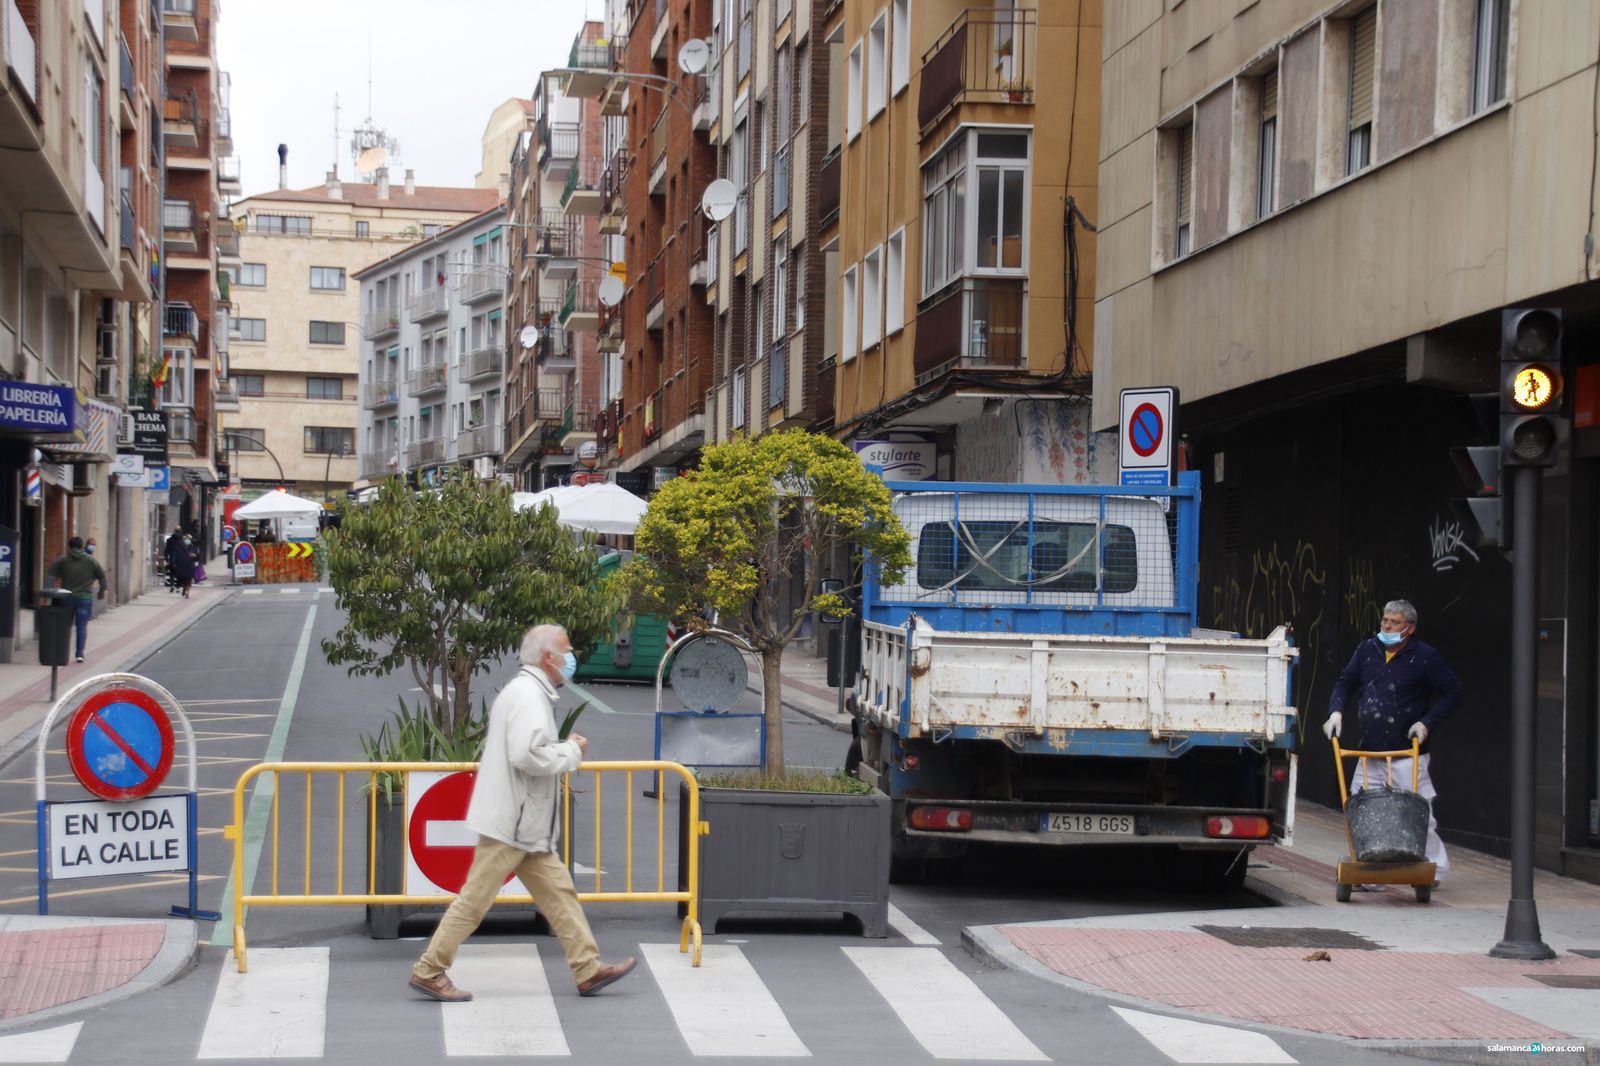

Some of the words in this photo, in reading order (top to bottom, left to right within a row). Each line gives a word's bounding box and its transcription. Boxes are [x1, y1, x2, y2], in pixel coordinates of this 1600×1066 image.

[3, 387, 62, 407] LIBRERÍA
[0, 404, 68, 426] PAPELERÍA
[138, 412, 161, 421] BAR
[134, 422, 167, 432] CHEMA
[870, 448, 922, 464] stylarte
[65, 813, 99, 836] EN
[106, 809, 175, 832] TODA
[1052, 815, 1092, 831] 4518
[1100, 816, 1129, 832] GGS
[61, 845, 93, 866] LA
[99, 838, 179, 863] CALLE
